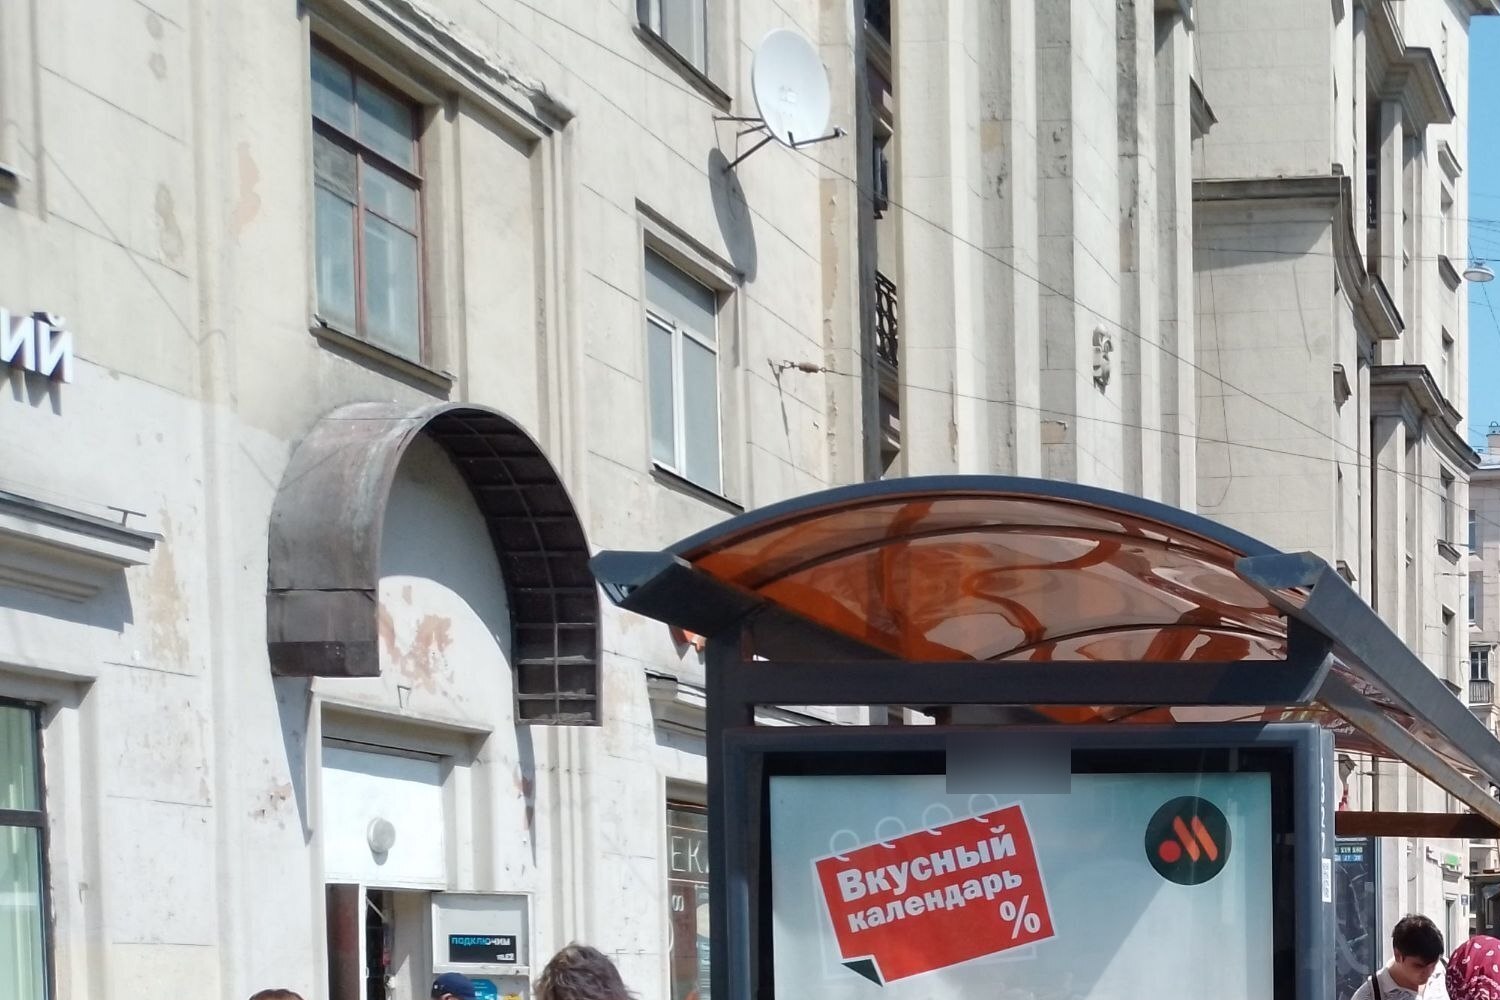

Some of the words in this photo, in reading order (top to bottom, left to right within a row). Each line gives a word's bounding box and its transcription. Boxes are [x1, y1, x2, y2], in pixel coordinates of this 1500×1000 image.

[671, 836, 710, 874] ЕК
[836, 824, 1017, 902] Вкусный
[847, 870, 1022, 933] календарь
[1000, 895, 1041, 940] %
